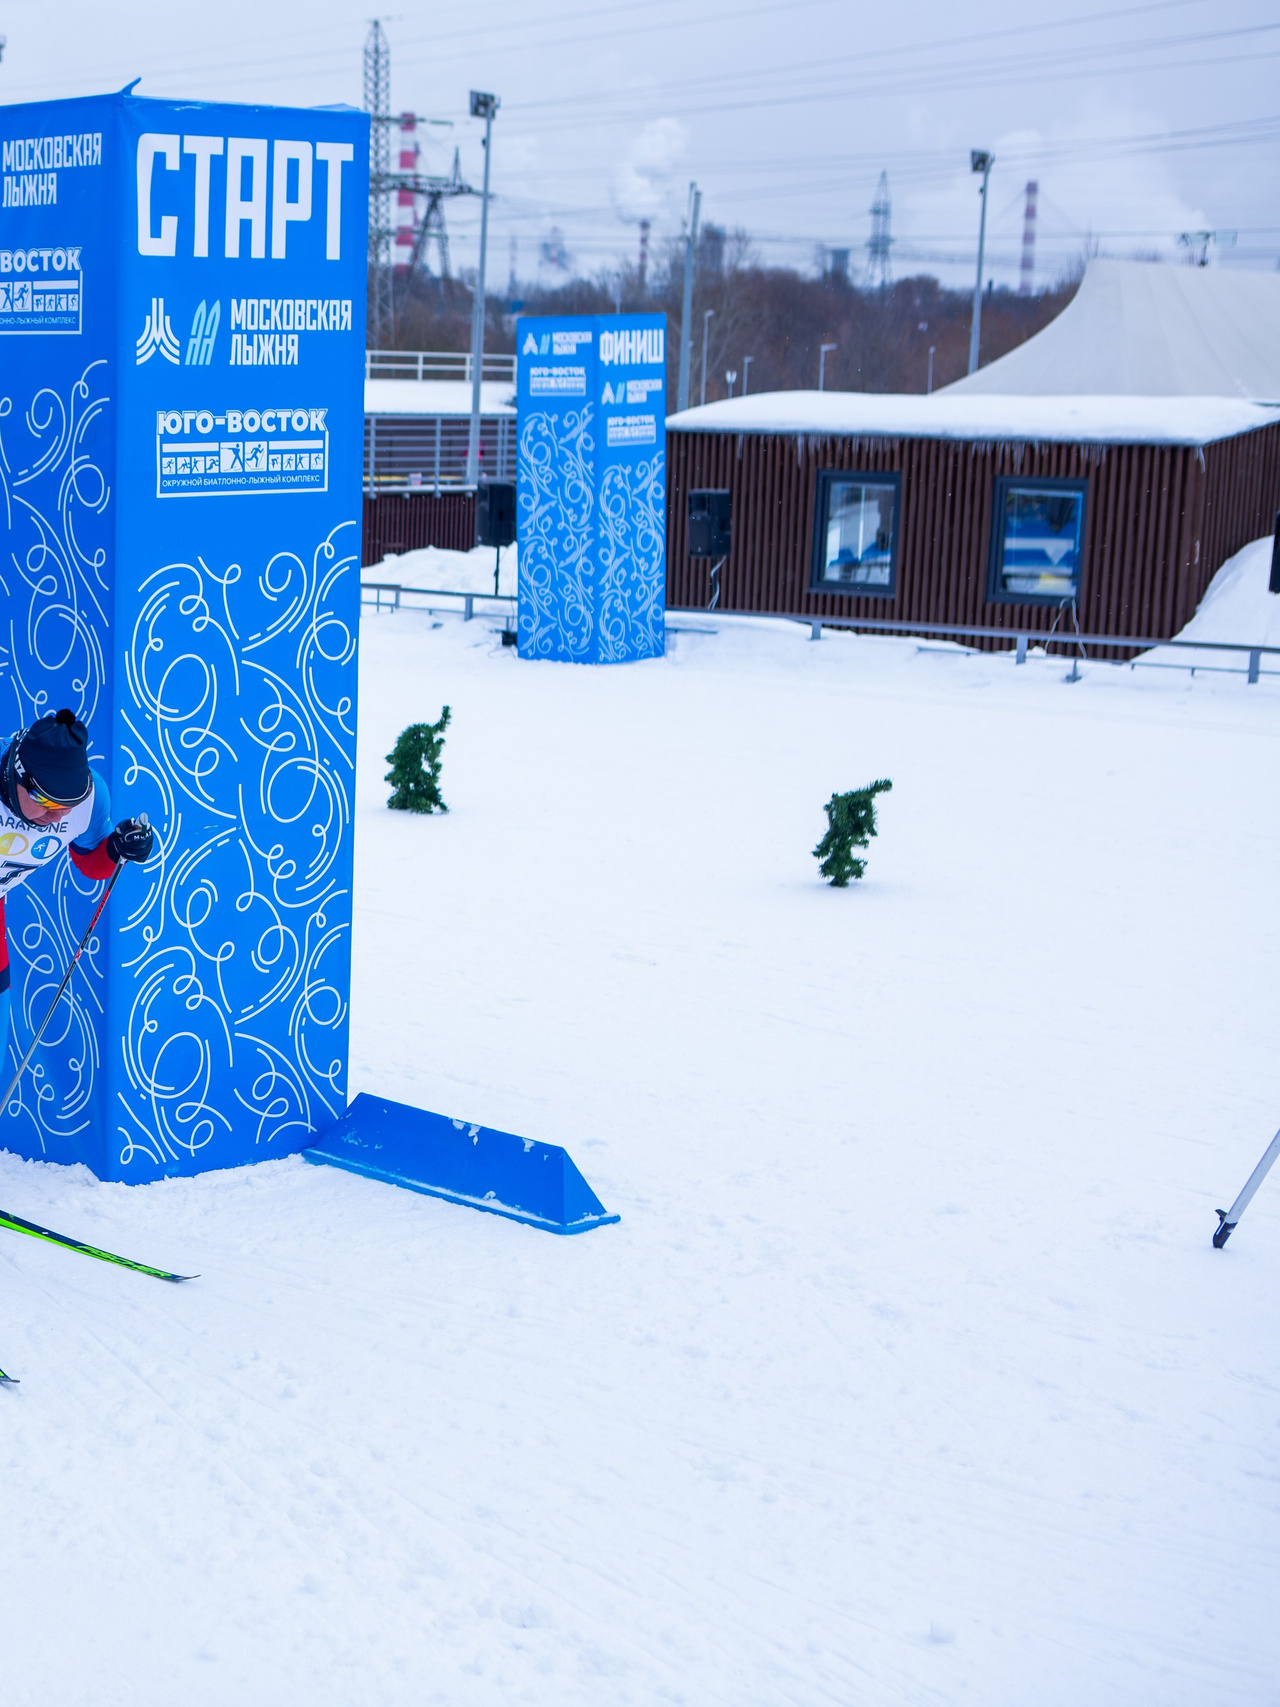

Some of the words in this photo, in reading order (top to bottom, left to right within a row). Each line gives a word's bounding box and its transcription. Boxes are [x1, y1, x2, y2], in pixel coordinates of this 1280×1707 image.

[2, 132, 102, 169] МОСКОВСКАЯ
[2, 172, 57, 208] ЛЫЖНЯ
[136, 133, 354, 261] СТАРТ
[230, 299, 352, 331] МОСКОВСКАЯ
[229, 334, 299, 365] ЛЫЖНЯ
[599, 329, 664, 366] ФИНИШ
[157, 409, 327, 435] ЮГО-ВОСТОК
[162, 477, 202, 487] ОКРУЖНОЙ
[203, 474, 282, 486] БИАТЛОННО-ЛЫЖНЫЙ
[282, 475, 320, 484] КОМПЛЕКС
